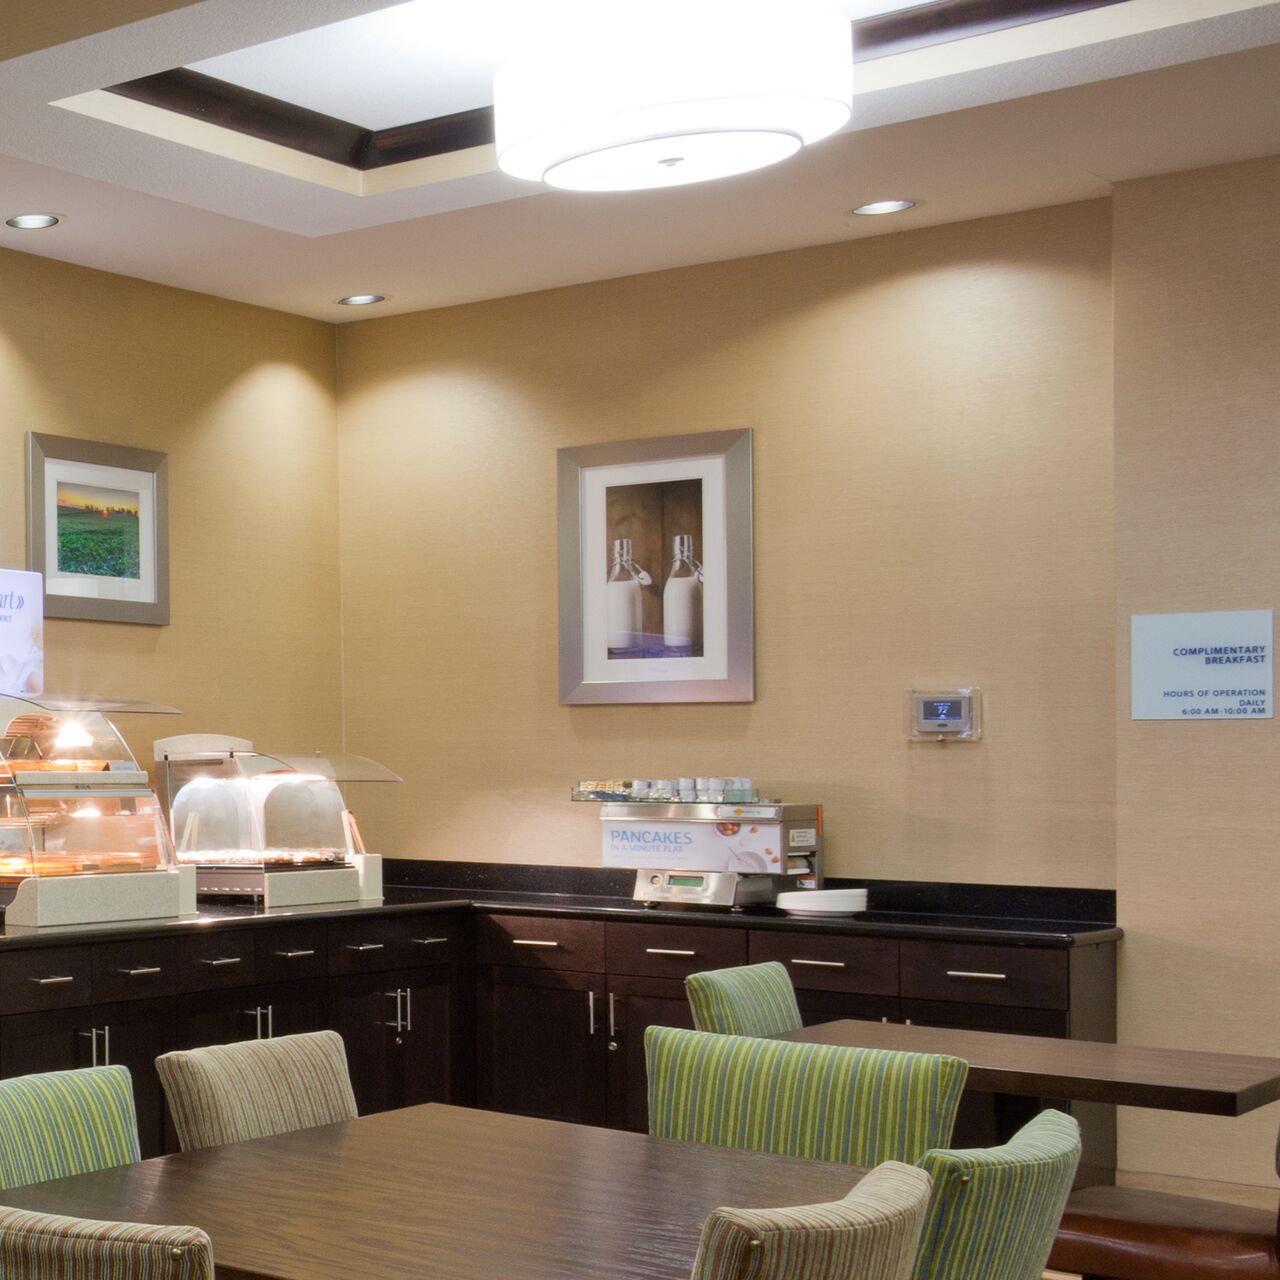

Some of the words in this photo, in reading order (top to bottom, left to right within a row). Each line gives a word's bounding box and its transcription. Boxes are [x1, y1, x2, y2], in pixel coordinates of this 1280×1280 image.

[1172, 646, 1265, 656] COMPLIMENTARY
[1204, 655, 1265, 664] BREAKFAST
[1197, 689, 1209, 697] OF
[1212, 689, 1265, 697] OPERATION
[610, 830, 694, 845] PANCAKES
